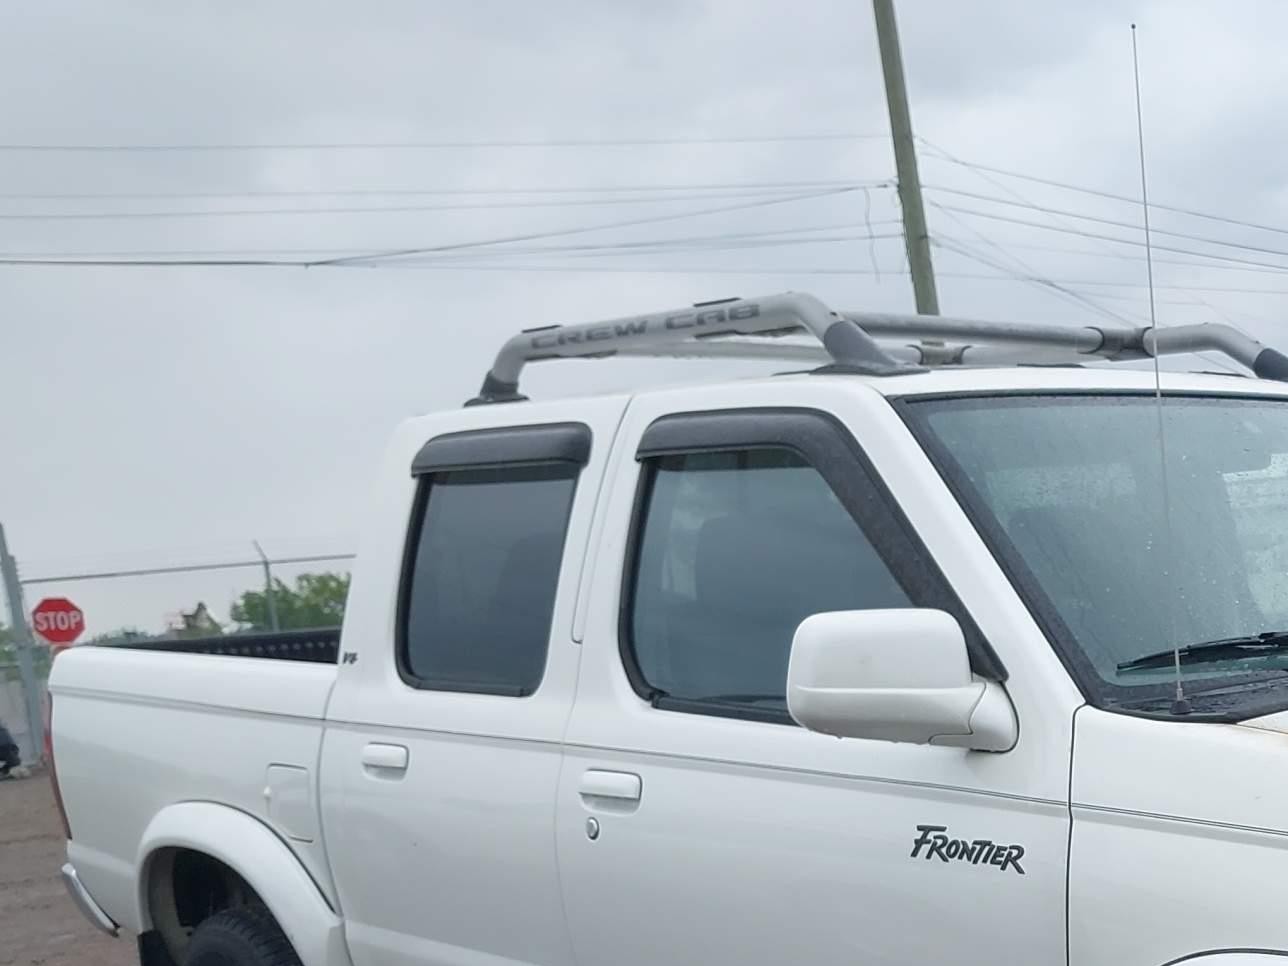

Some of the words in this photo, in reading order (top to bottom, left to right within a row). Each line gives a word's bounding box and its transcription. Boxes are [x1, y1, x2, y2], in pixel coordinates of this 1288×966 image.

[531, 319, 648, 350] CREW
[665, 303, 760, 329] CAB
[35, 611, 81, 632] STOP
